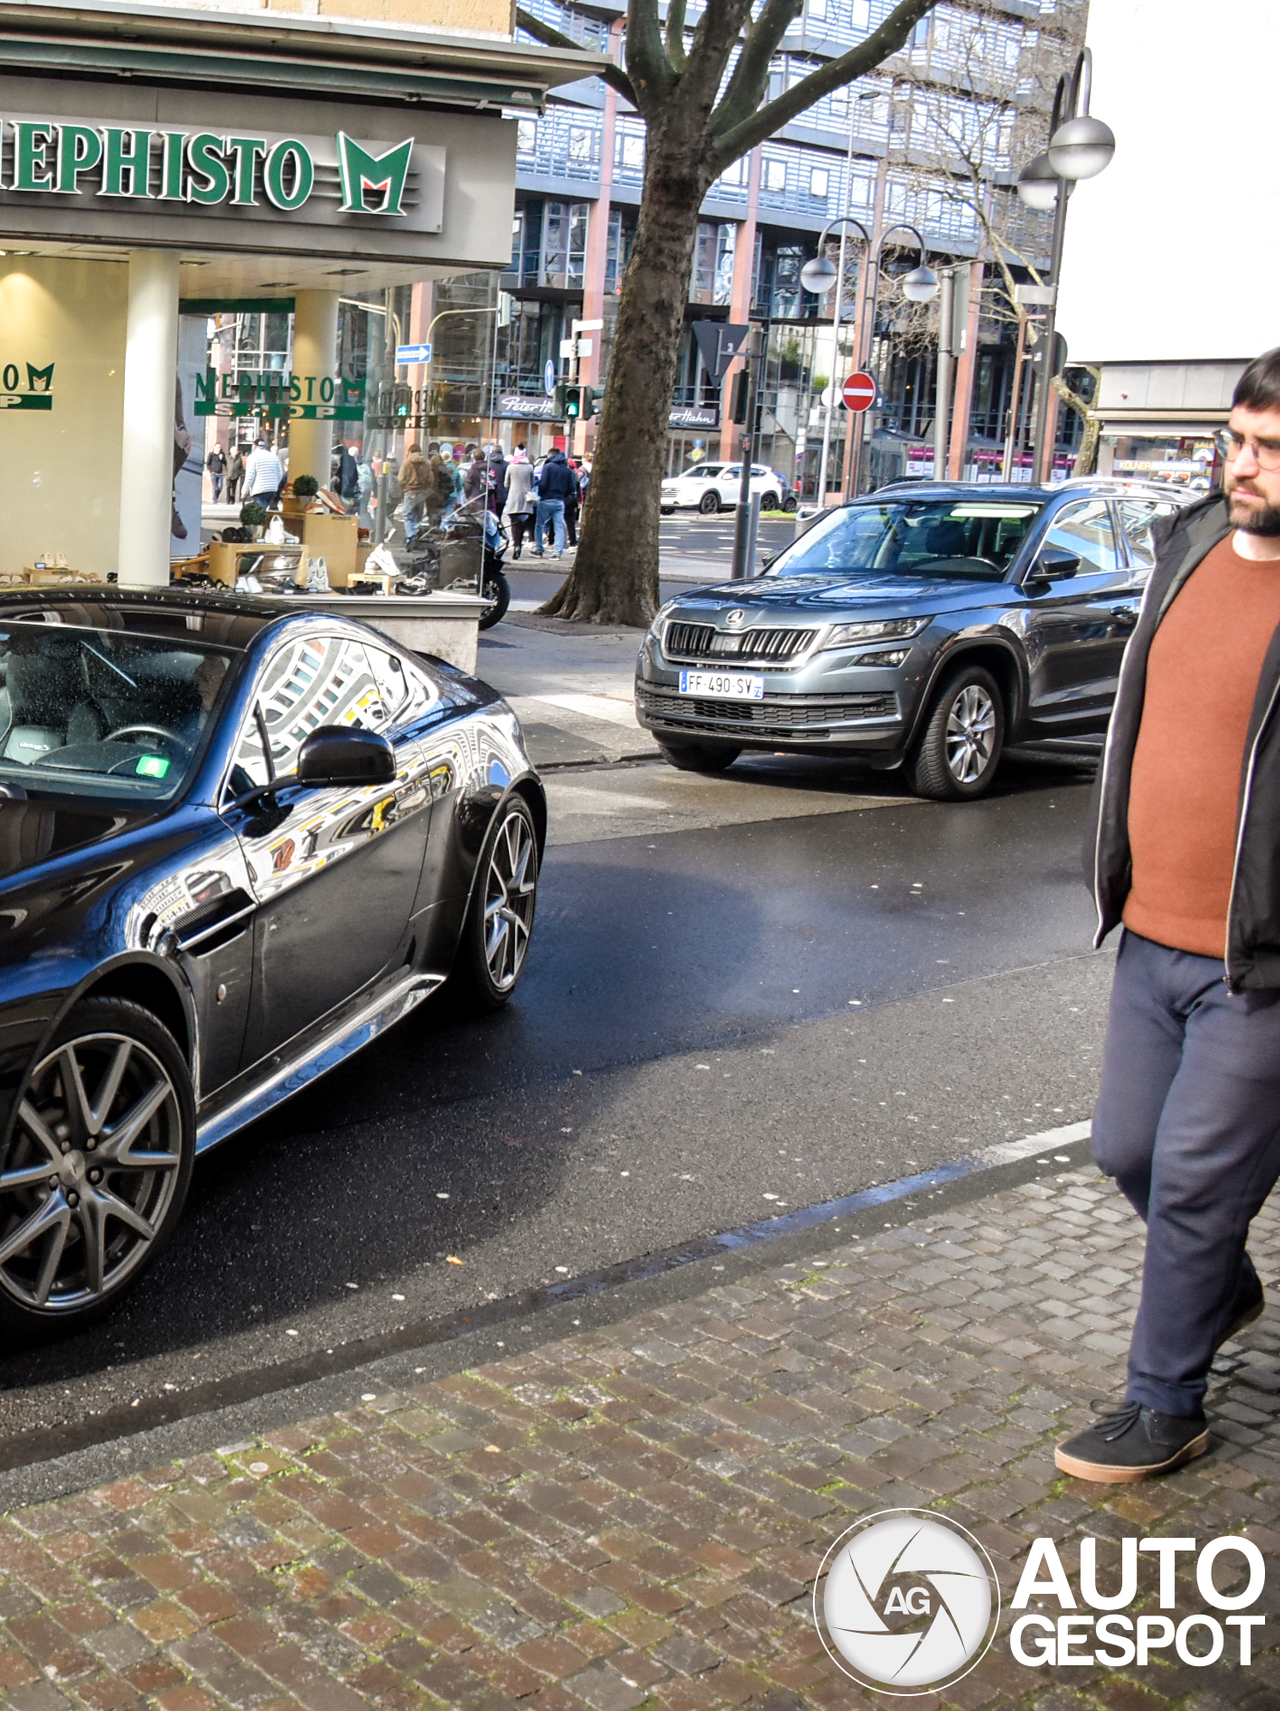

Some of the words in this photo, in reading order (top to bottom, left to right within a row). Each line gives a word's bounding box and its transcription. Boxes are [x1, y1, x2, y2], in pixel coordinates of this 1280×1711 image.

[195, 372, 335, 403] MEPHISTO
[214, 403, 337, 418] SHOP
[501, 396, 539, 414] Peter
[682, 410, 715, 424] Hahn
